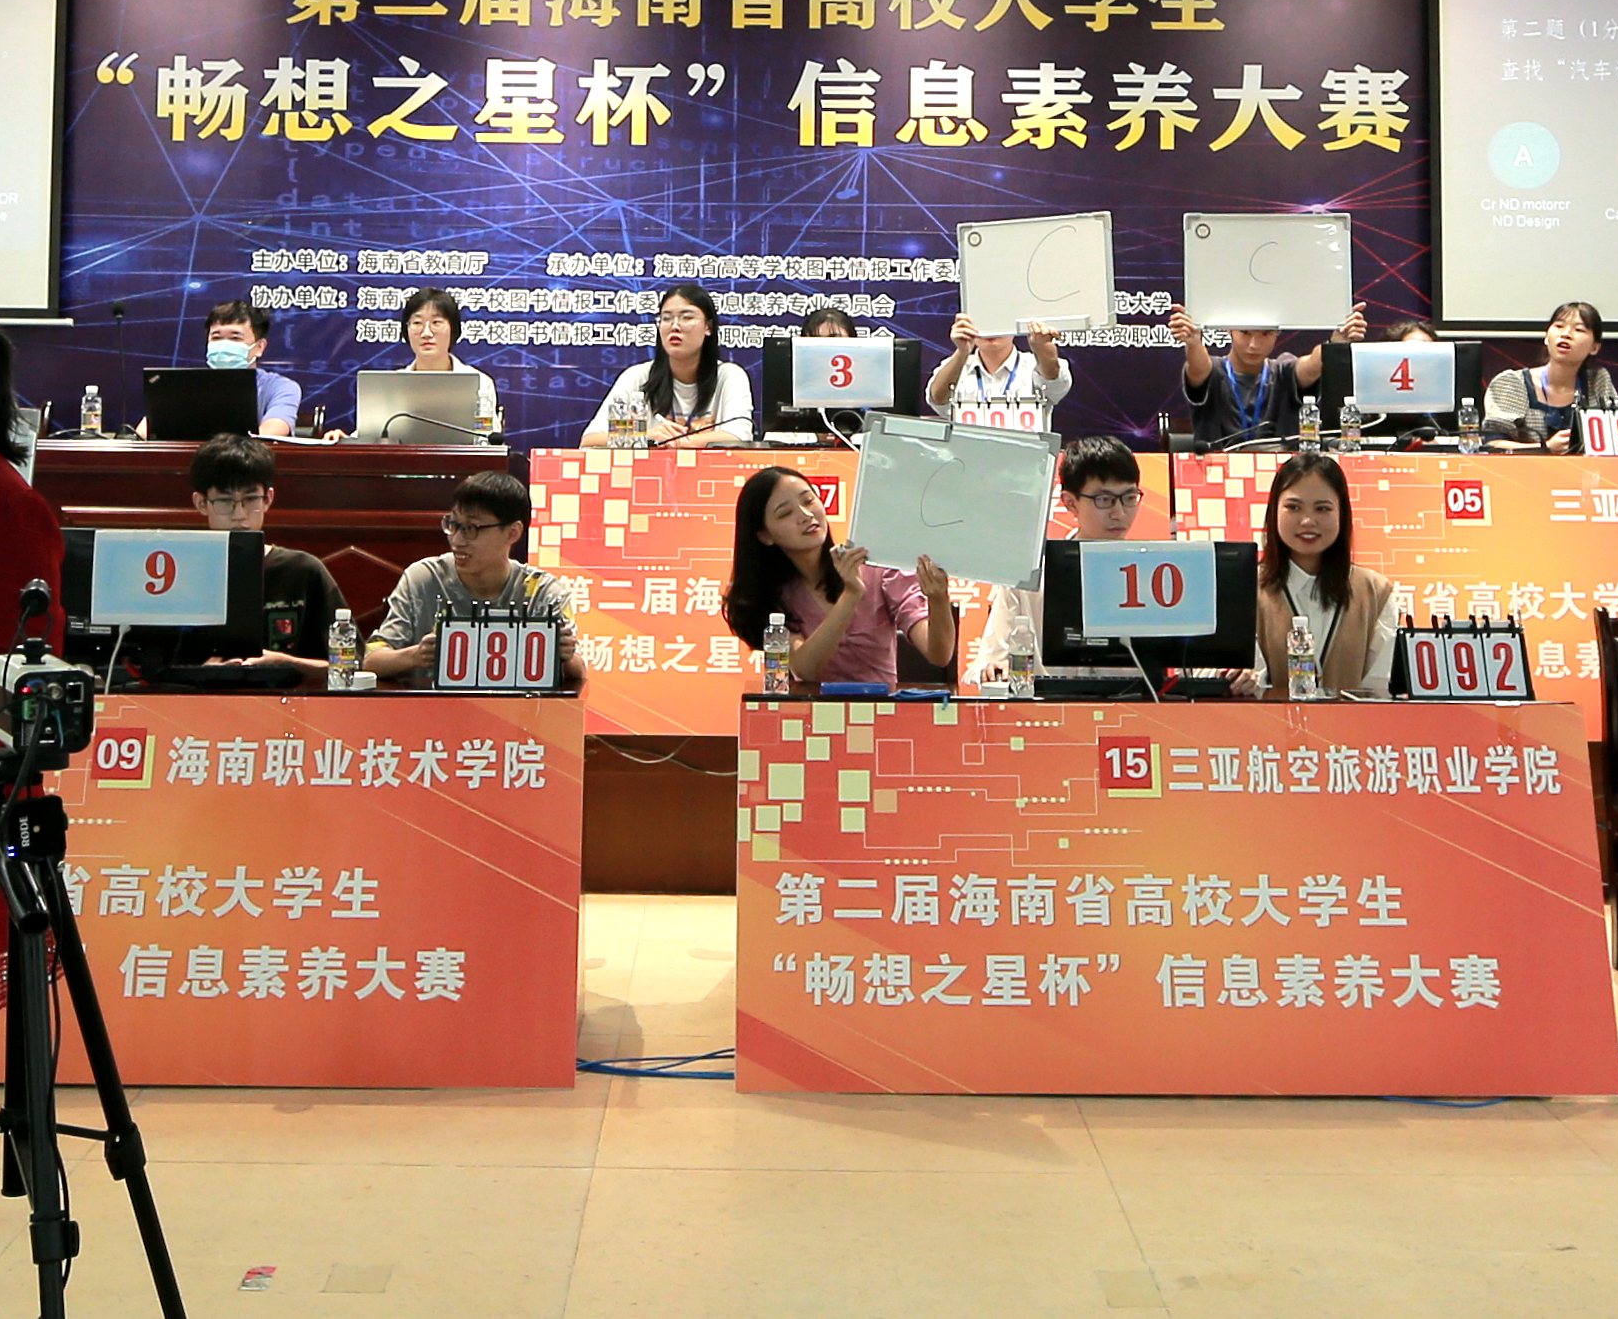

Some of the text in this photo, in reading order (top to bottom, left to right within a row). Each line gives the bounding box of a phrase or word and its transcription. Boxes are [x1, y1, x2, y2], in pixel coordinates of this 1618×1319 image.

[1513, 145, 1534, 167] A
[1516, 214, 1560, 230] Design
[546, 252, 961, 283] 承办单位：海南省高等学校图书情报工作委
[1026, 225, 1082, 302] C
[1249, 240, 1280, 284] C
[828, 353, 854, 388] 3
[1389, 357, 1415, 391] 4
[920, 457, 966, 528] C
[1447, 488, 1483, 513] 05
[144, 549, 177, 596] 9
[1118, 562, 1185, 609] 10
[446, 630, 546, 683] 080
[1415, 640, 1518, 691] 092
[95, 735, 143, 773] 09
[165, 735, 547, 792] 海南职业技术学院
[1104, 749, 1149, 781] 15
[1167, 745, 1563, 797] 三亚航空旅游职业学院
[773, 872, 1410, 928] 第二届海南省高校大学生
